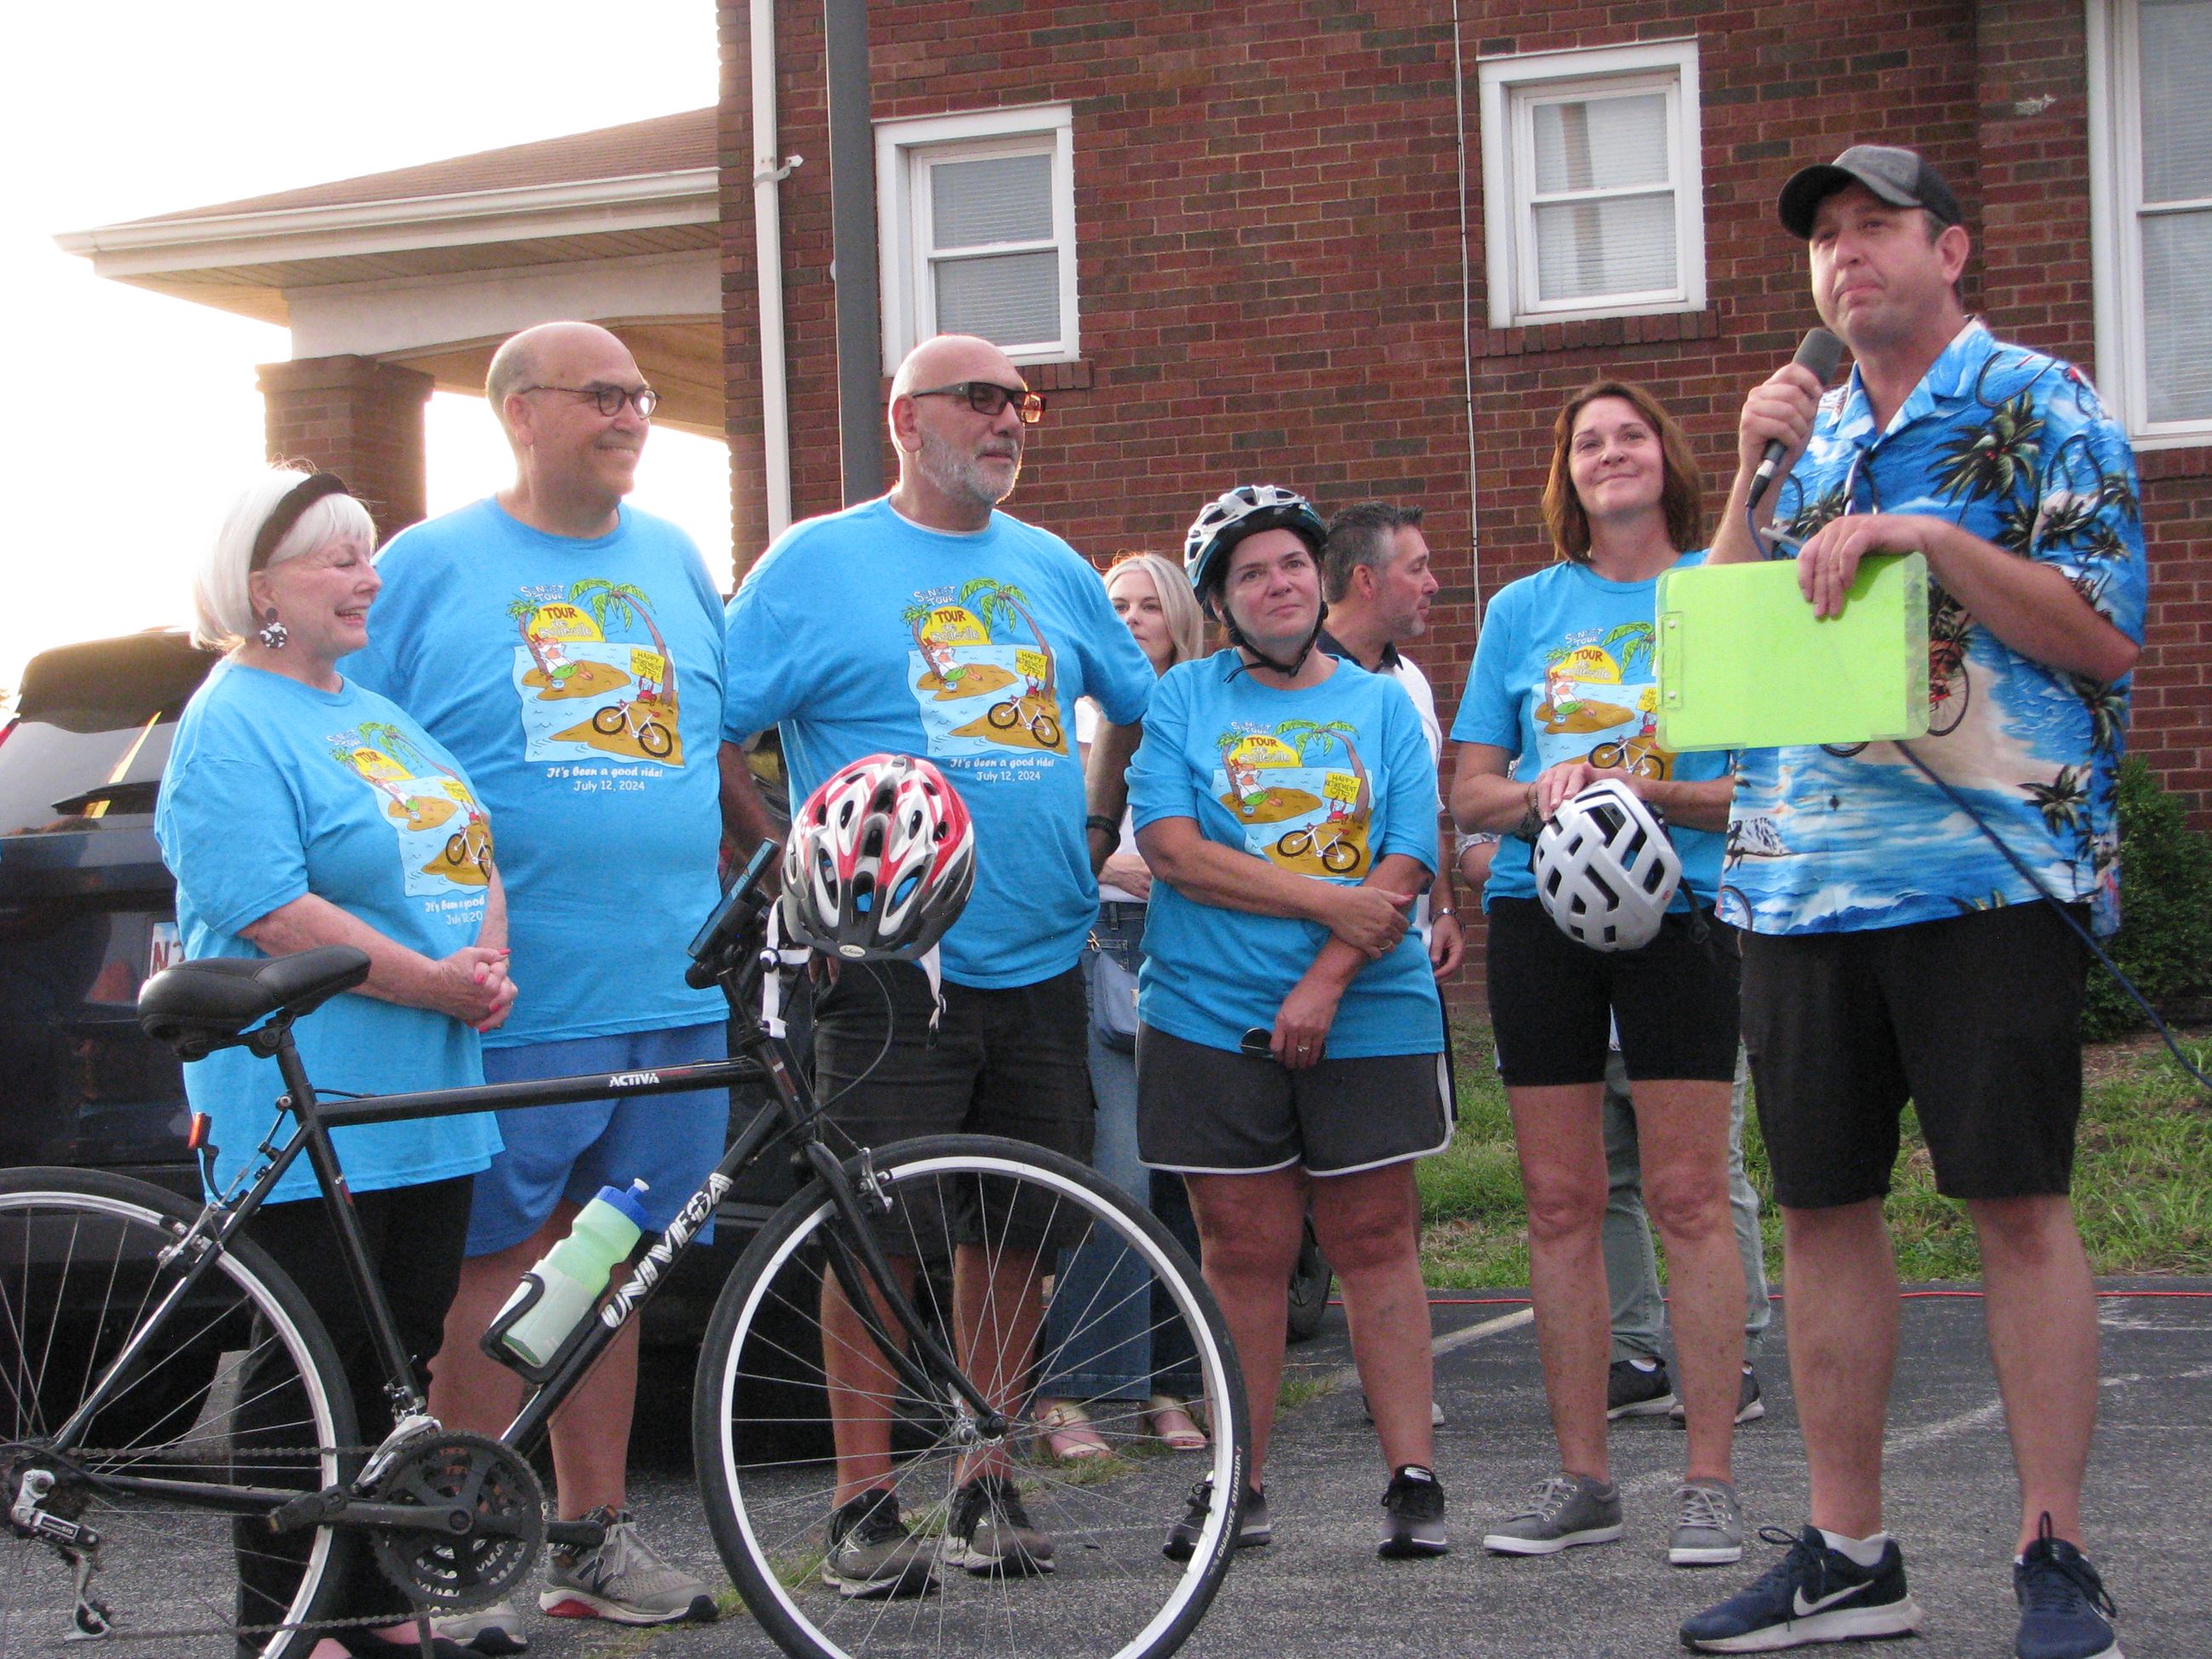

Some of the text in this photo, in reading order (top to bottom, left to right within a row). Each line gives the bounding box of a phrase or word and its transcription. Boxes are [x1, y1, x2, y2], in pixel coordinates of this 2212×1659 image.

[543, 607, 578, 619] TOUR
[934, 610, 966, 623] TOUR
[1574, 649, 1603, 663] TOUR
[1246, 737, 1278, 747] TOUR
[1010, 757, 1034, 768] good
[573, 767, 597, 776] been
[601, 767, 607, 776] a
[612, 767, 638, 778] good
[976, 771, 1040, 783] July 12, 2024
[573, 780, 645, 793] July 12, 2024
[609, 1073, 660, 1087] ACTIVA
[601, 1172, 733, 1328] UNIVEGA
